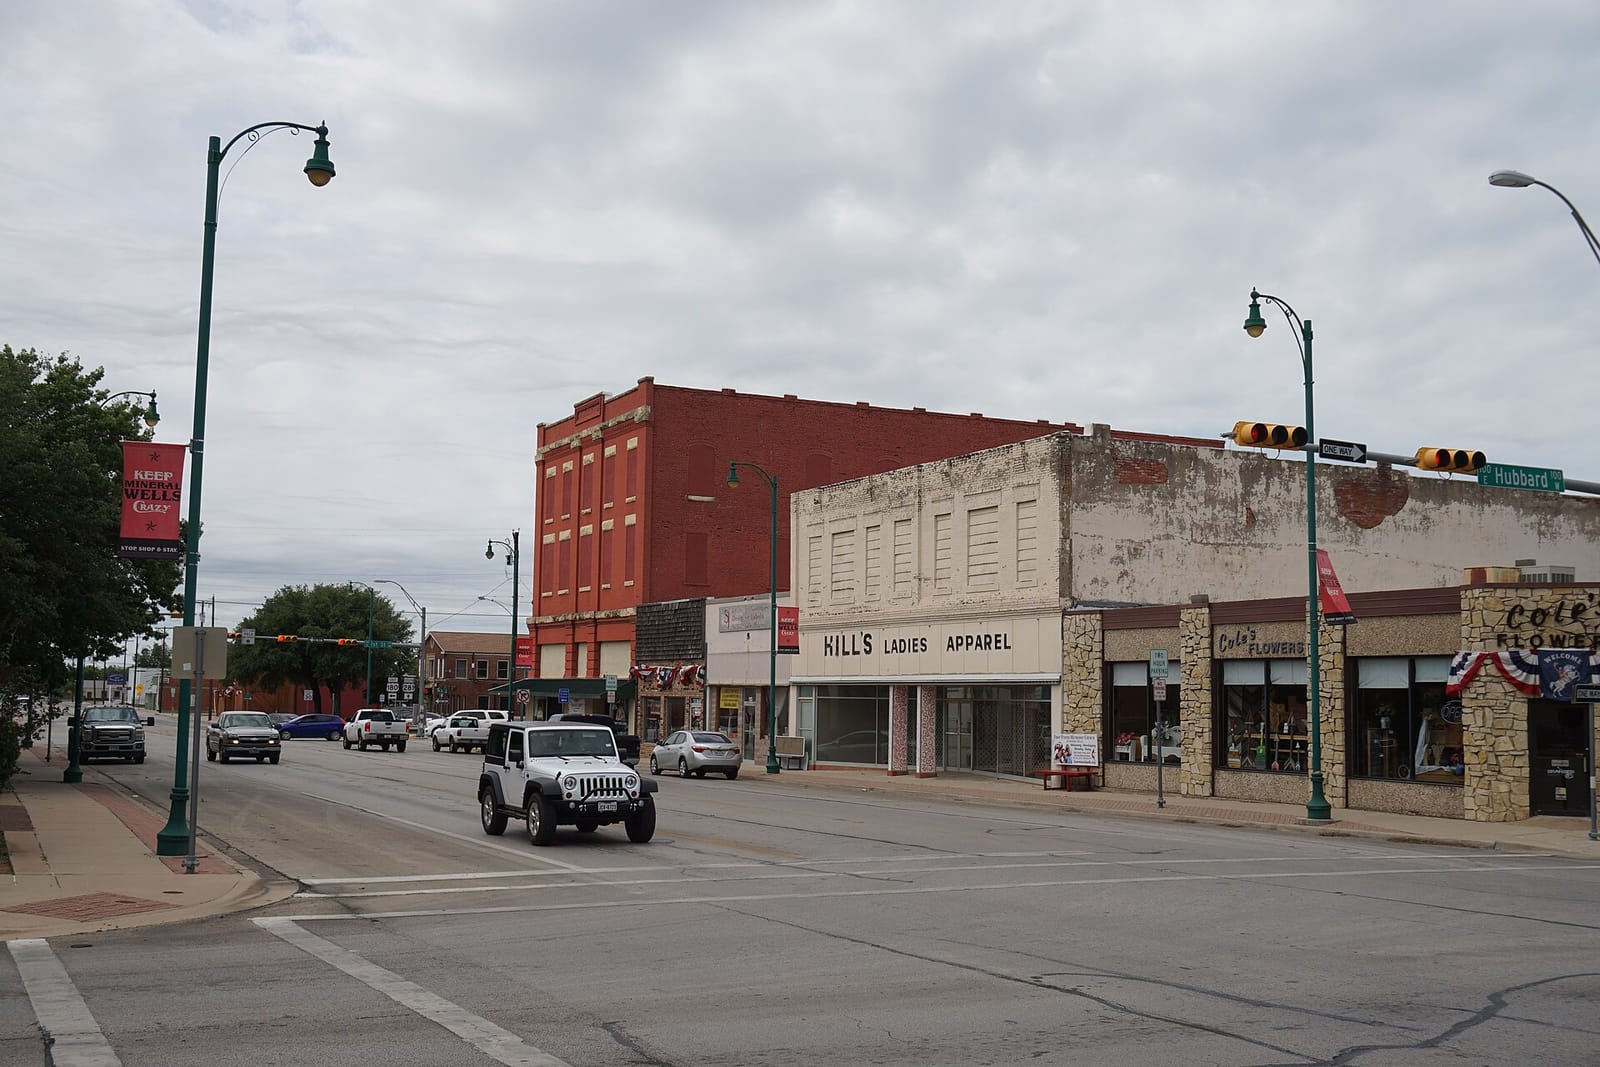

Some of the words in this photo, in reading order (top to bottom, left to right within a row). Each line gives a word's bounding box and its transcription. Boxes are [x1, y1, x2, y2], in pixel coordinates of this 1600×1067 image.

[1324, 445, 1337, 454] ONE
[1339, 447, 1352, 456] WAY
[133, 470, 174, 480] KEEP
[1483, 475, 1488, 485] E
[1495, 467, 1548, 488] Hubbard
[124, 480, 181, 489] MINERAL
[124, 489, 181, 501] WELLS
[884, 637, 928, 655] LADIES
[946, 633, 1012, 651] APPAREL
[1219, 626, 1257, 652] Cole's
[1248, 642, 1305, 655] FLOWERS
[1543, 653, 1583, 665] WELCOME
[1444, 706, 1462, 718] OPE
